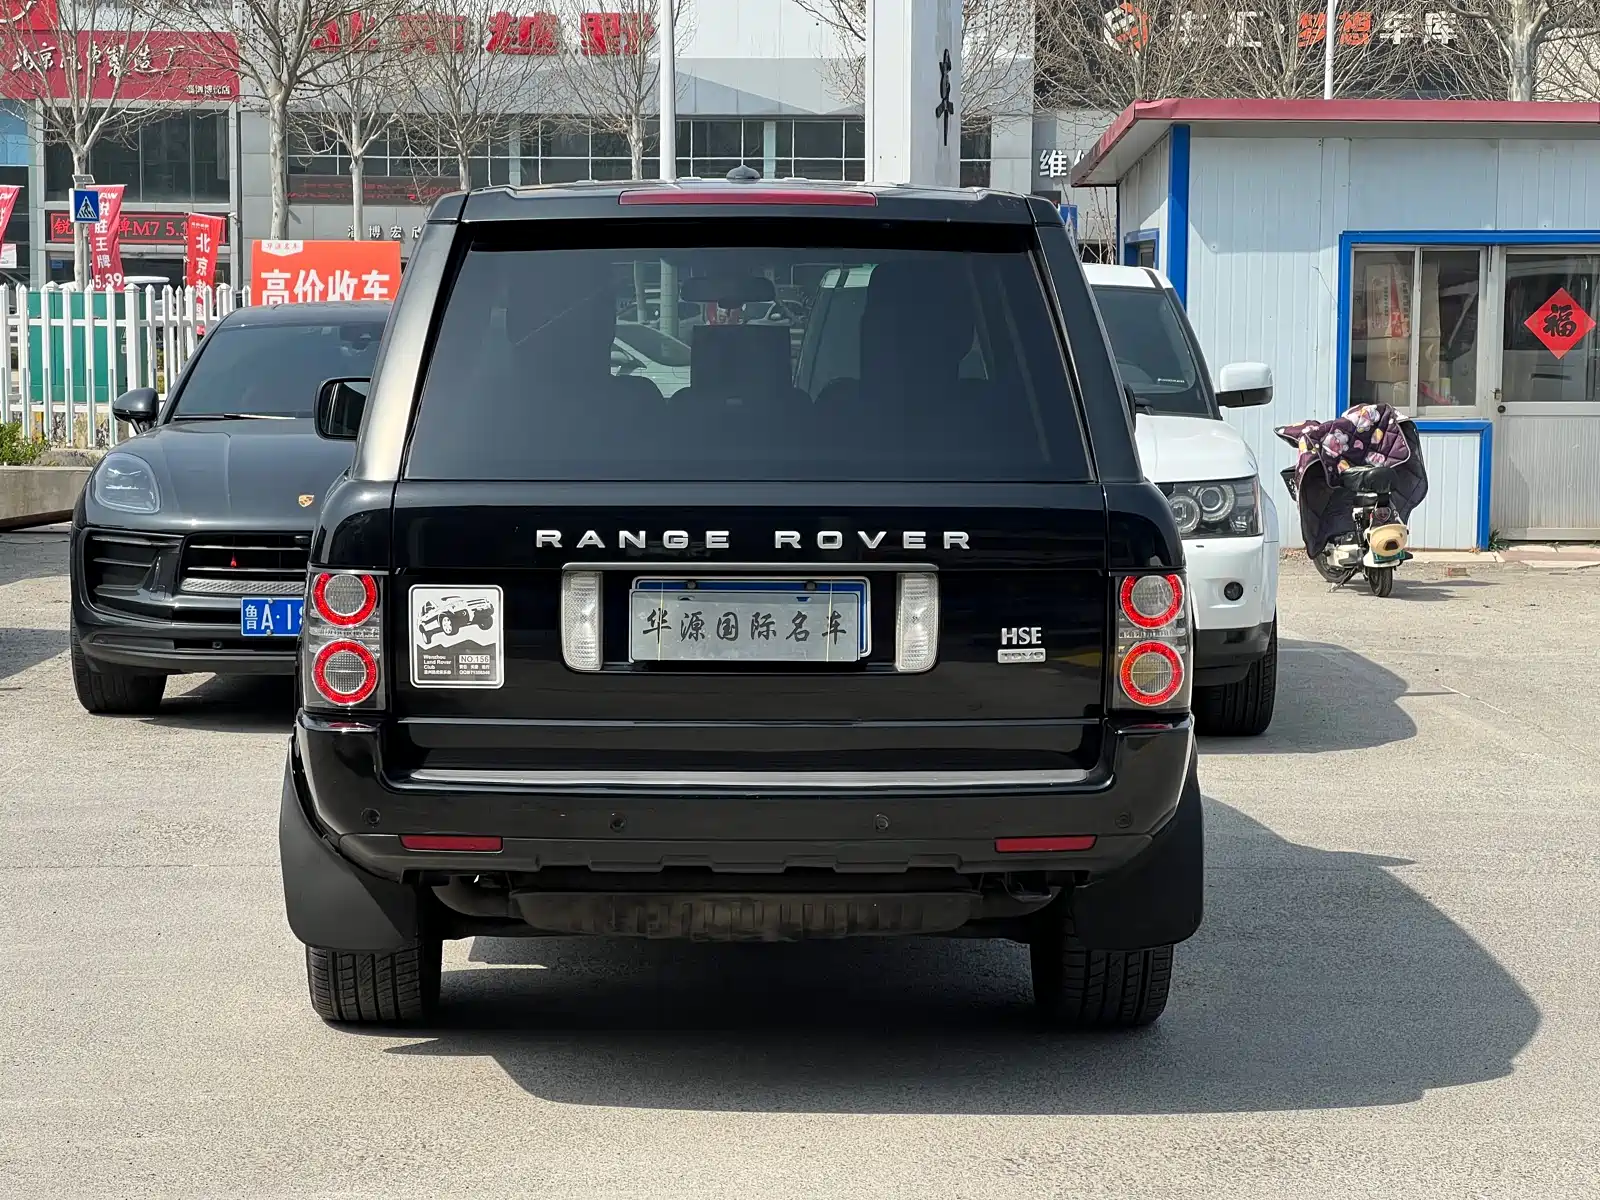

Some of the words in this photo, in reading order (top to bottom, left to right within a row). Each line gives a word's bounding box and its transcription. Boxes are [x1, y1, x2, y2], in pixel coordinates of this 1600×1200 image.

[261, 268, 390, 306] 高价收车
[1543, 304, 1577, 337] 福
[536, 529, 730, 549] RANGE
[775, 530, 971, 550] ROVER
[643, 609, 848, 645] 华源国际名车
[1001, 627, 1042, 645] HSE
